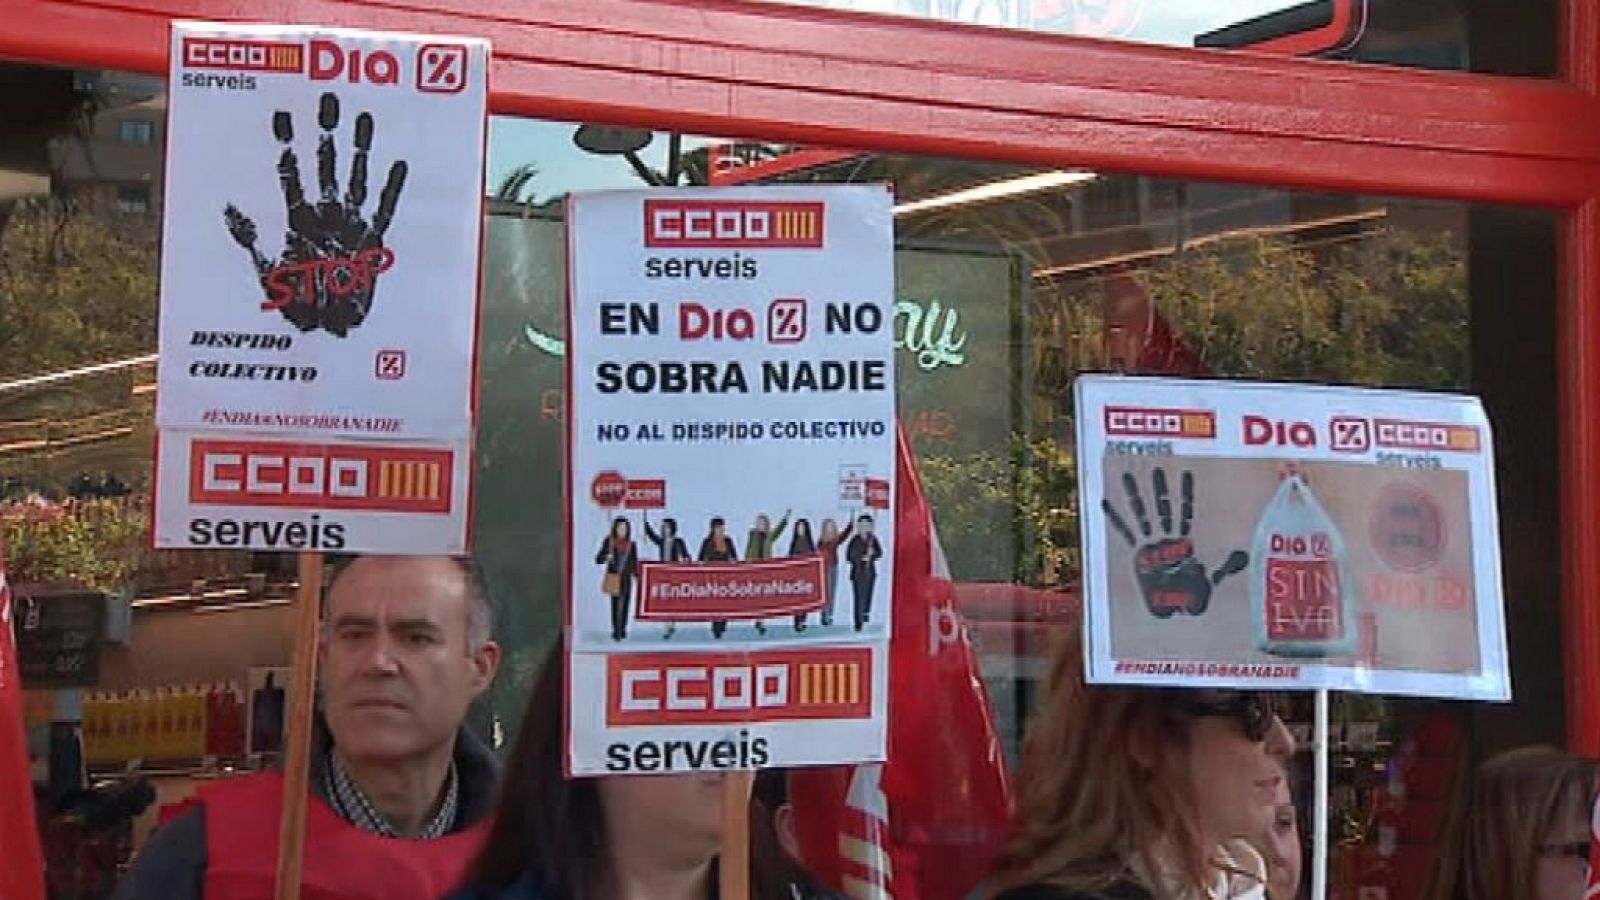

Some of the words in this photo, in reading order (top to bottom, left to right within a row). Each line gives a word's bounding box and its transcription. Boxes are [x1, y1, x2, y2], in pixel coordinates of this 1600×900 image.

[188, 43, 268, 65] CCOO
[182, 72, 257, 90] serveis
[653, 210, 769, 239] CCOO
[260, 247, 395, 311] STOP
[645, 253, 758, 279] serveis
[600, 303, 659, 335] EN
[826, 302, 882, 333] NO
[190, 330, 293, 351] DESPIDO
[189, 361, 318, 382] COLECTIVO
[596, 361, 748, 394] SOBRA
[762, 361, 886, 393] NADIE
[597, 424, 630, 442] NO
[637, 424, 664, 441] AL
[673, 422, 764, 440] DESPIDO
[770, 420, 886, 438] COLECTIVO
[1109, 411, 1181, 432] CCOO
[1379, 424, 1448, 446] CCOO
[203, 453, 368, 497] CCOO
[1375, 450, 1443, 471] serveis
[189, 515, 346, 549] serveis
[651, 578, 814, 600] #EnDiaNoSobraNadie
[1270, 566, 1338, 601] SIN
[621, 663, 789, 711] CCOO
[606, 729, 769, 771] serveis
